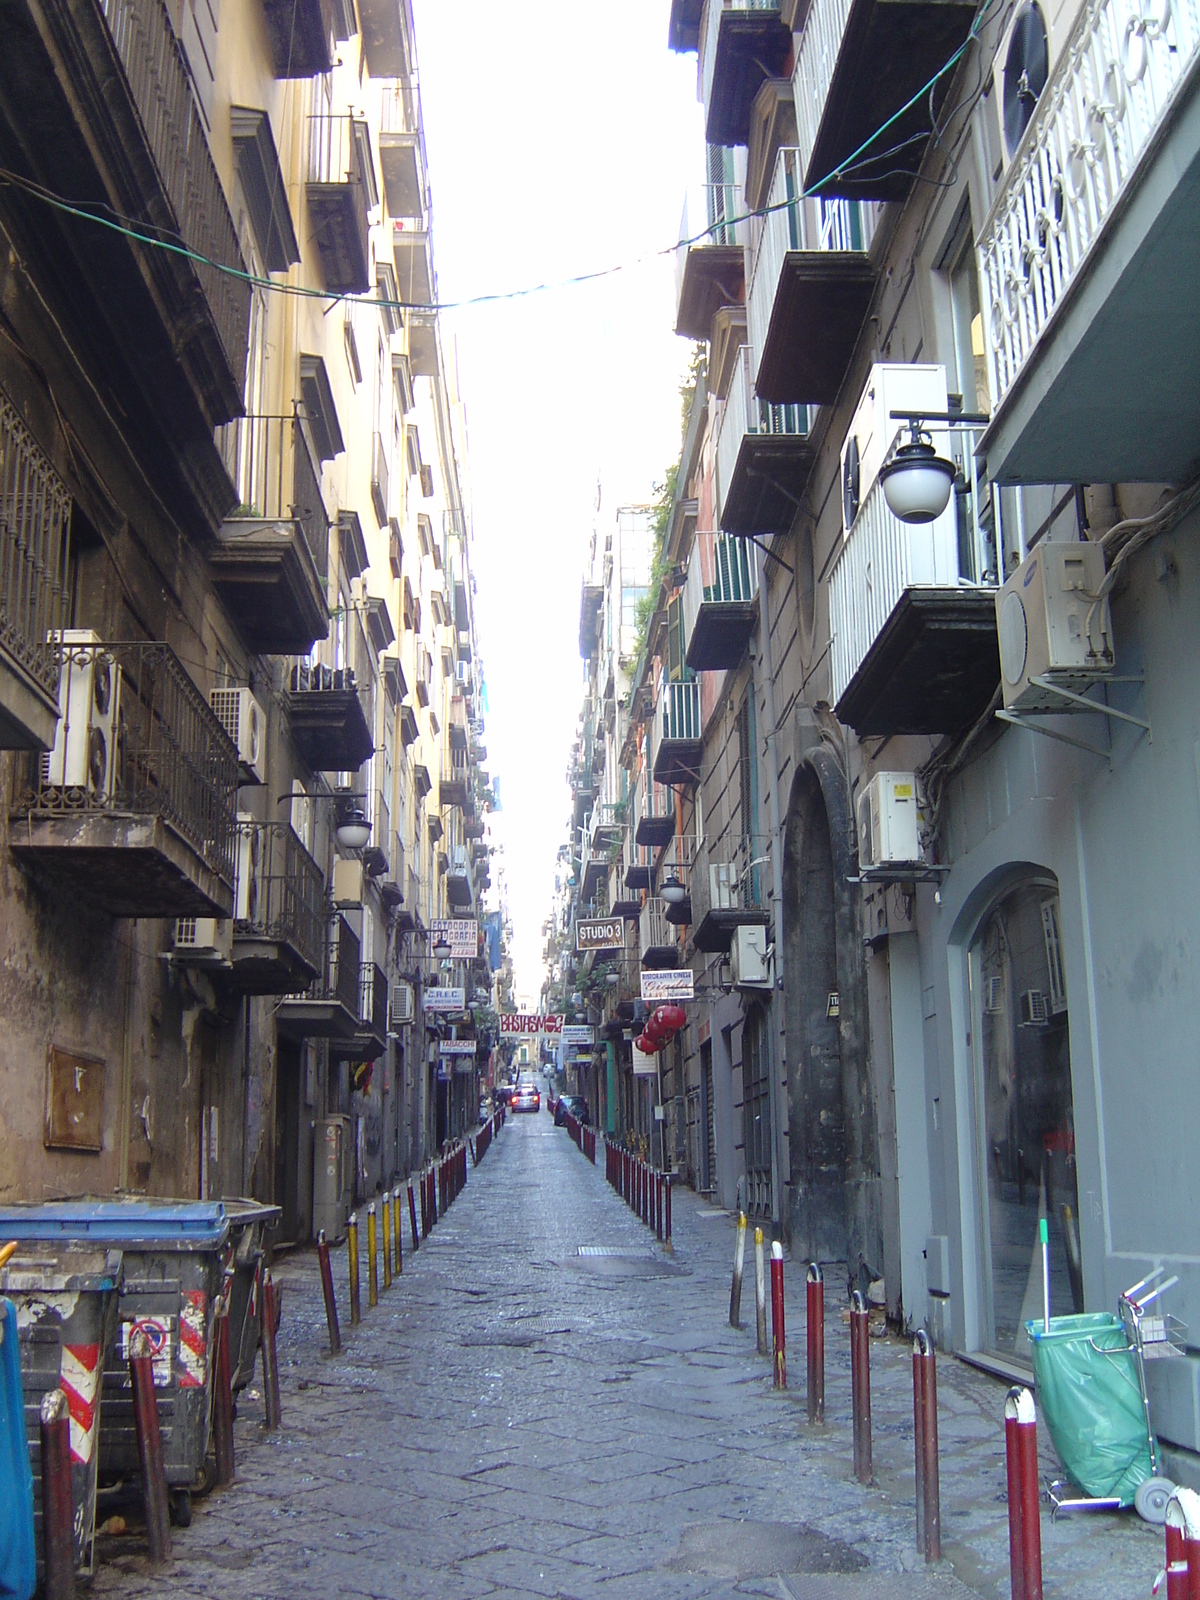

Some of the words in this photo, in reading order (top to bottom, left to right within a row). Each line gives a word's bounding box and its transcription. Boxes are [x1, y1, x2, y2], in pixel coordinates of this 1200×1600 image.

[432, 921, 477, 931] FOTOCOPIE
[580, 925, 614, 940] STUDIO
[615, 924, 621, 938] 3
[442, 1040, 475, 1048] TABACCHI
